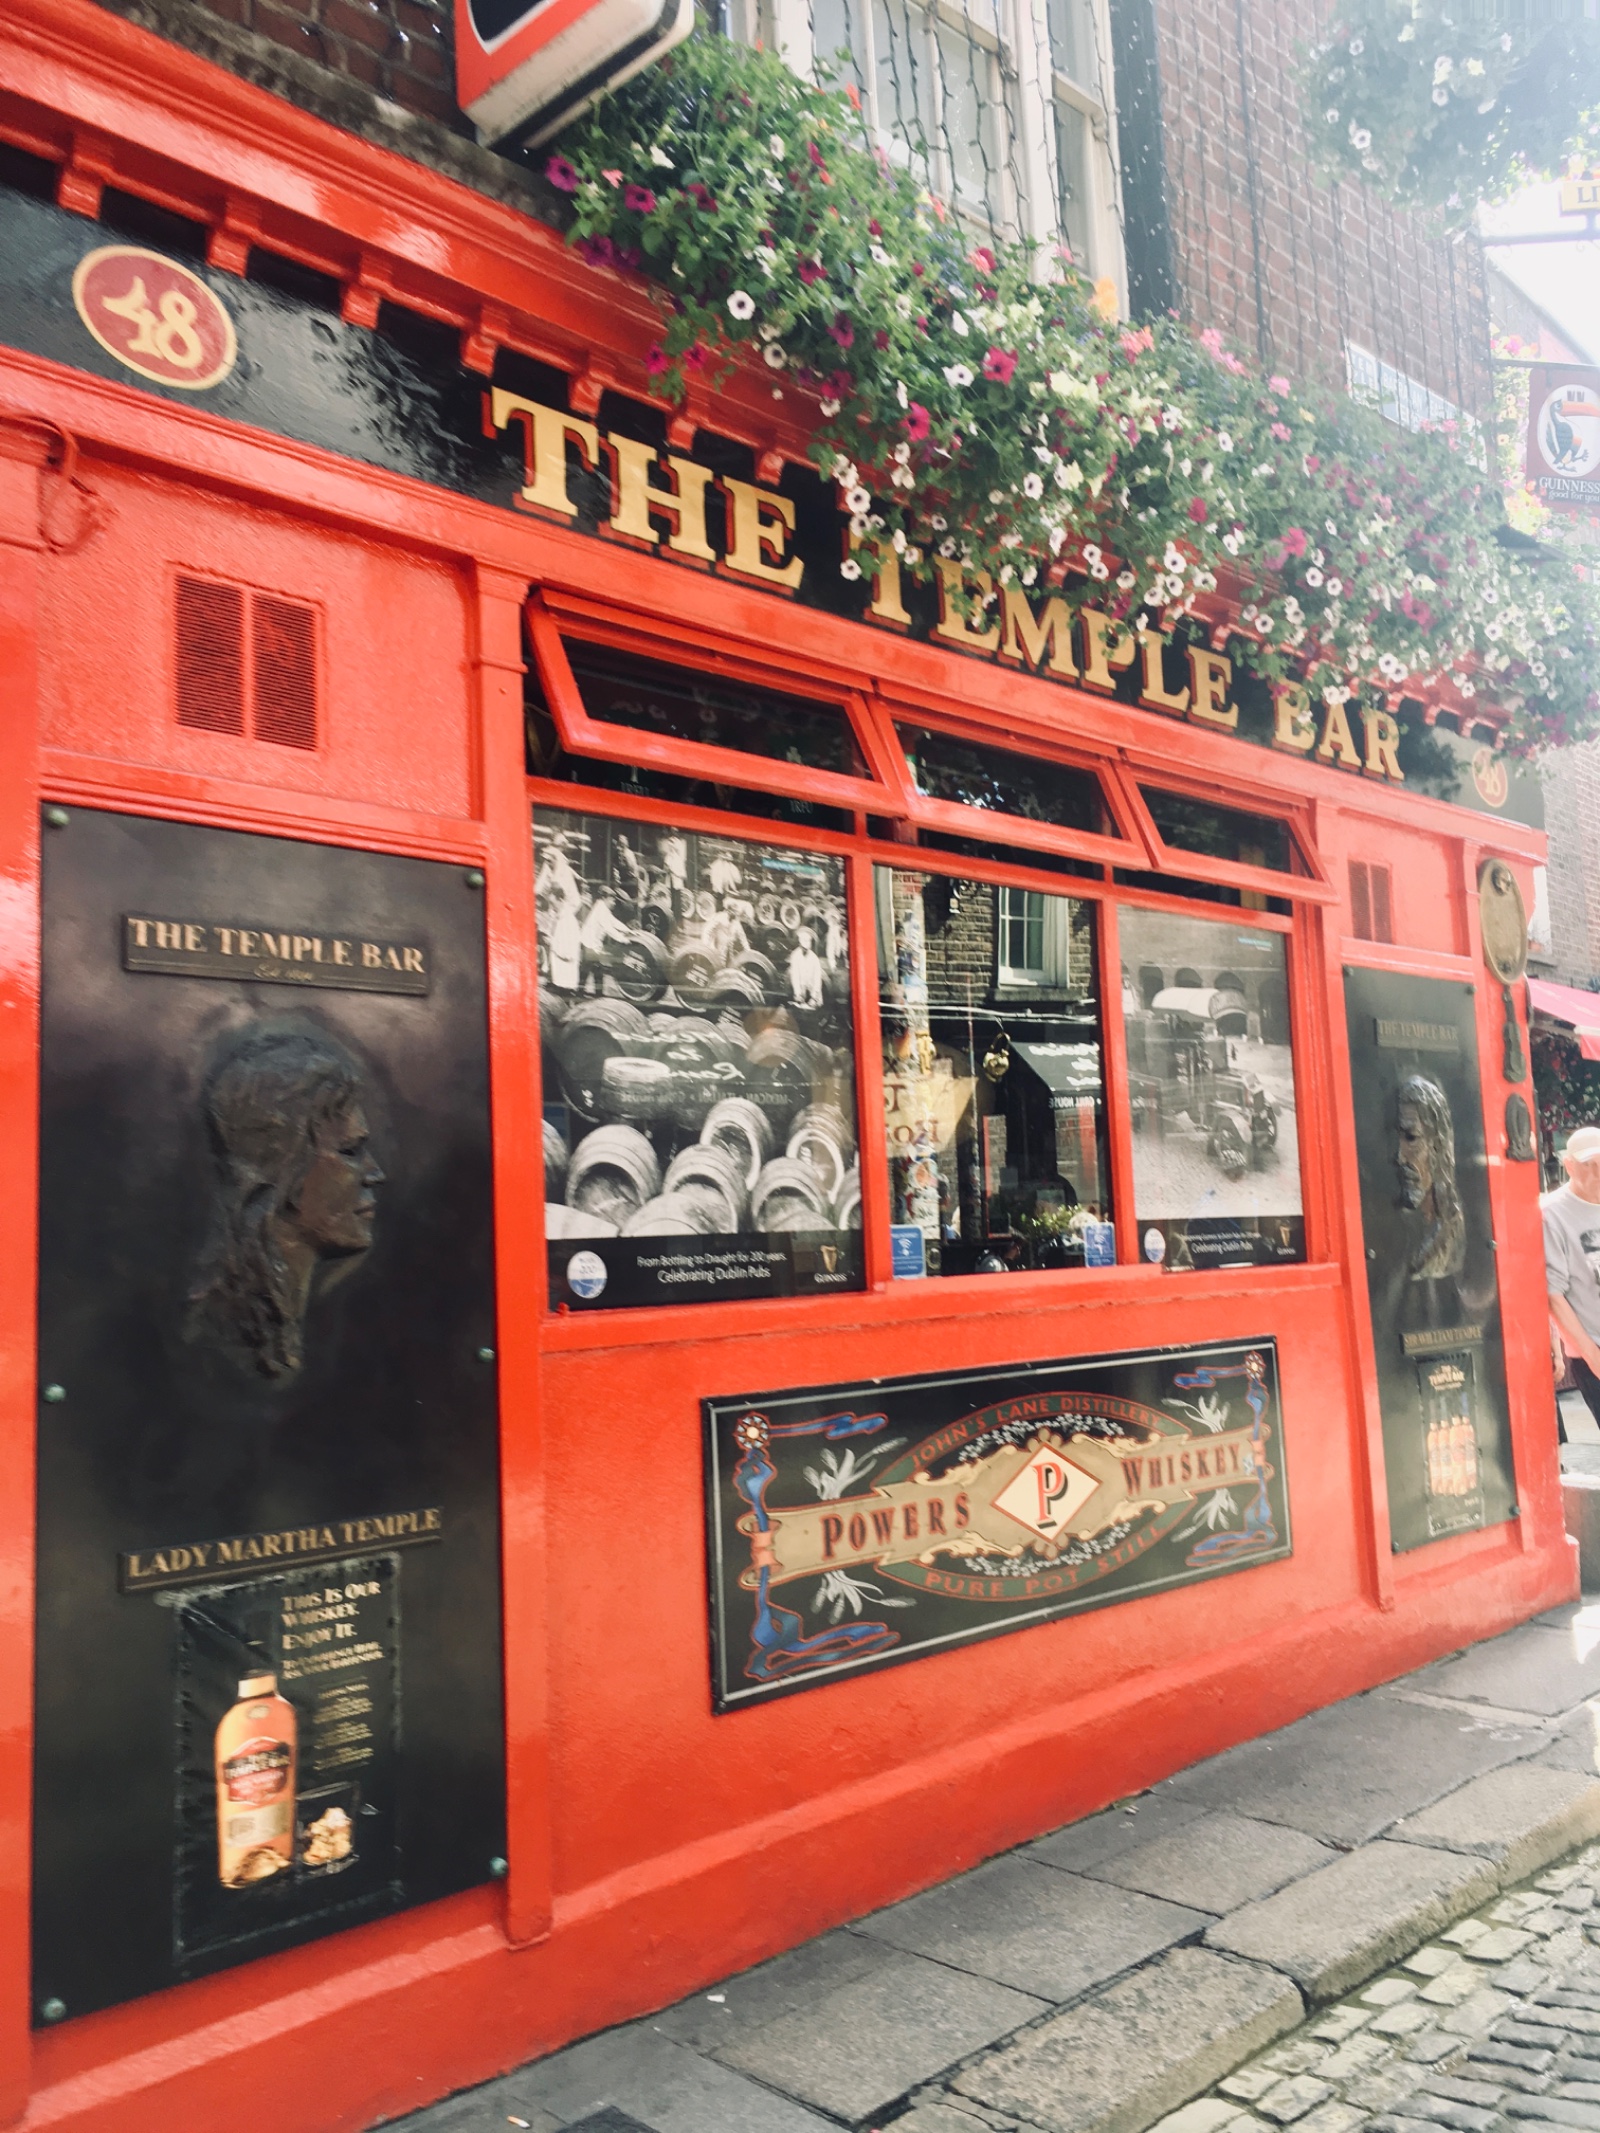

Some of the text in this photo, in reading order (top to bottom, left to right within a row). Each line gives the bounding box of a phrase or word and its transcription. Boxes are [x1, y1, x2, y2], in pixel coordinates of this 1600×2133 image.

[102, 275, 202, 370] 48
[485, 386, 1405, 782] THE TEMPLE BAR
[127, 918, 426, 973] THE TEMPLE BAR
[637, 1255, 660, 1268] From
[657, 1264, 771, 1284] Celebrating Dublin Pubs
[911, 1397, 1160, 1469] JOHN'S LANE DISTILLERY
[820, 1442, 1240, 1561] POWERS WHISKEY
[1032, 1461, 1068, 1530] P
[128, 1507, 443, 1579] LADY MARTHA TEMPLE
[924, 1524, 1161, 1598] PURE POT STILL
[324, 1587, 343, 1604] IS
[344, 1581, 382, 1600] OUR
